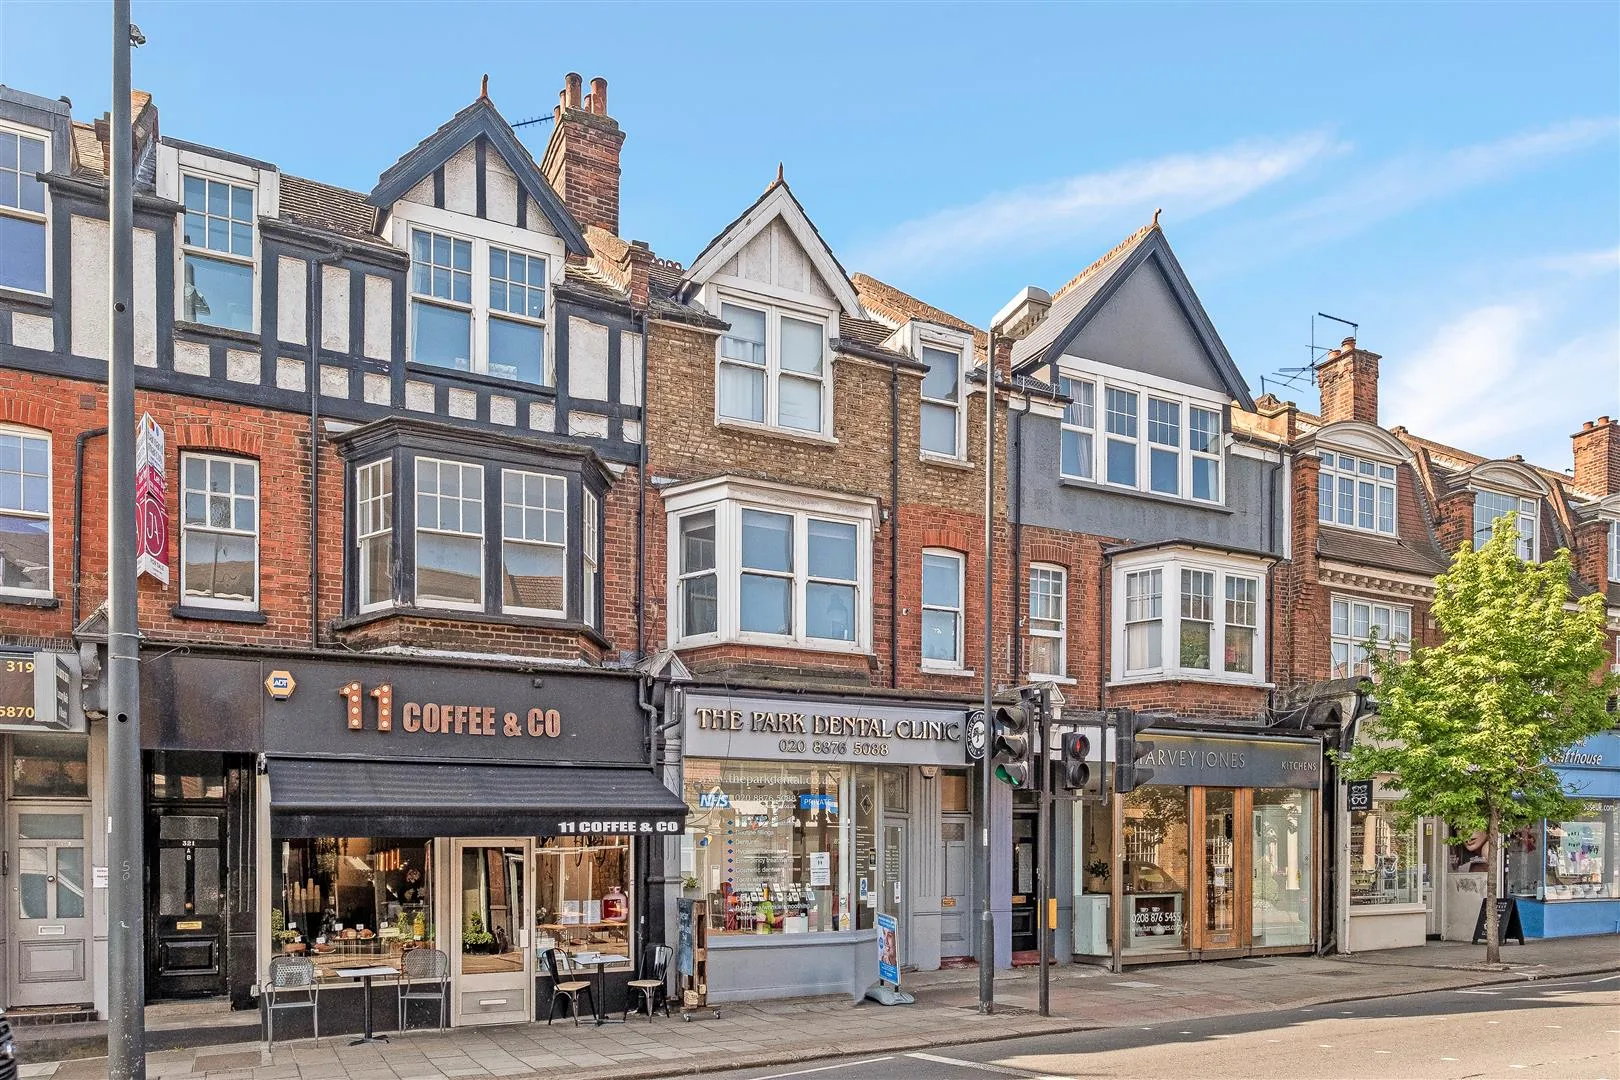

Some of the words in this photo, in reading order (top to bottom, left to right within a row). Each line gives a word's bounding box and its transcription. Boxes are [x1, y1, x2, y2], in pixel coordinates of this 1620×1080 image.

[6, 660, 35, 673] 319
[273, 679, 288, 687] ADT
[339, 680, 393, 731] 11
[402, 702, 496, 735] COFFEE
[503, 711, 522, 737] &
[527, 708, 561, 738] CO
[696, 707, 744, 731] THE
[750, 711, 807, 734] PARK
[813, 714, 893, 738] DENTAL
[895, 719, 961, 742] CLINIC
[778, 738, 806, 753] 020
[813, 739, 847, 755] 8876
[852, 741, 889, 756] 5088
[1200, 751, 1246, 770] JONES
[1280, 760, 1317, 771] KITCHENS
[700, 794, 730, 808] NHS
[734, 793, 751, 801] 020
[754, 793, 773, 802] 8876
[803, 797, 832, 806] PRIVATE
[558, 821, 575, 833] 11
[579, 821, 637, 833] COFFEE
[640, 822, 653, 832] &
[656, 821, 678, 832] CO
[1131, 913, 1149, 923] 0208
[1150, 912, 1163, 922] 876
